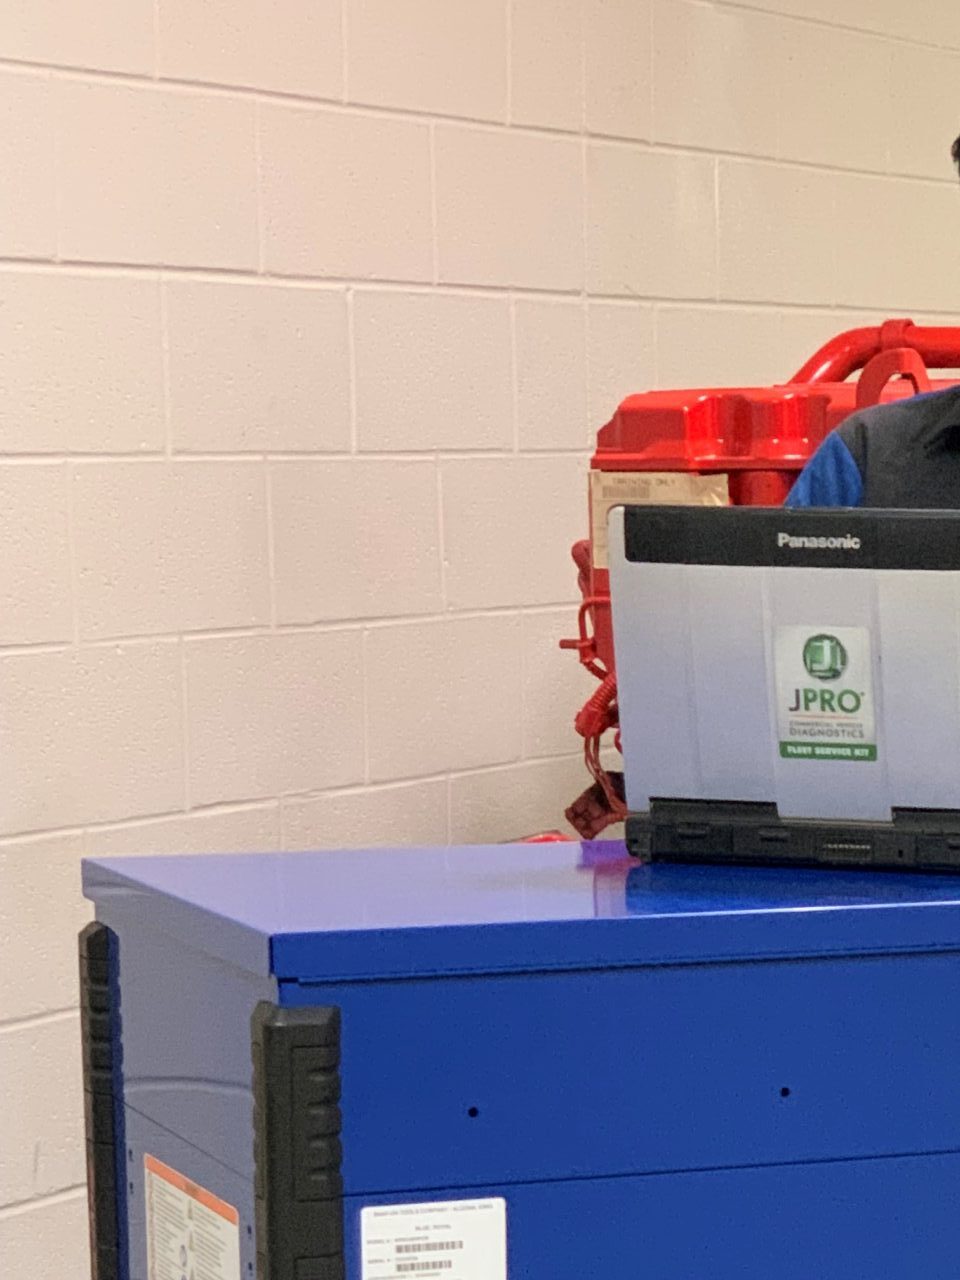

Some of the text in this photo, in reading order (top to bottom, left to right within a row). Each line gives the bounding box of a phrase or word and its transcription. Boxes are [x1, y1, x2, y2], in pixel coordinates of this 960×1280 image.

[777, 532, 861, 550] Panasonic
[789, 728, 865, 738] DIAGNOSTICS
[787, 745, 870, 757] FLEET SERVICE KIT
